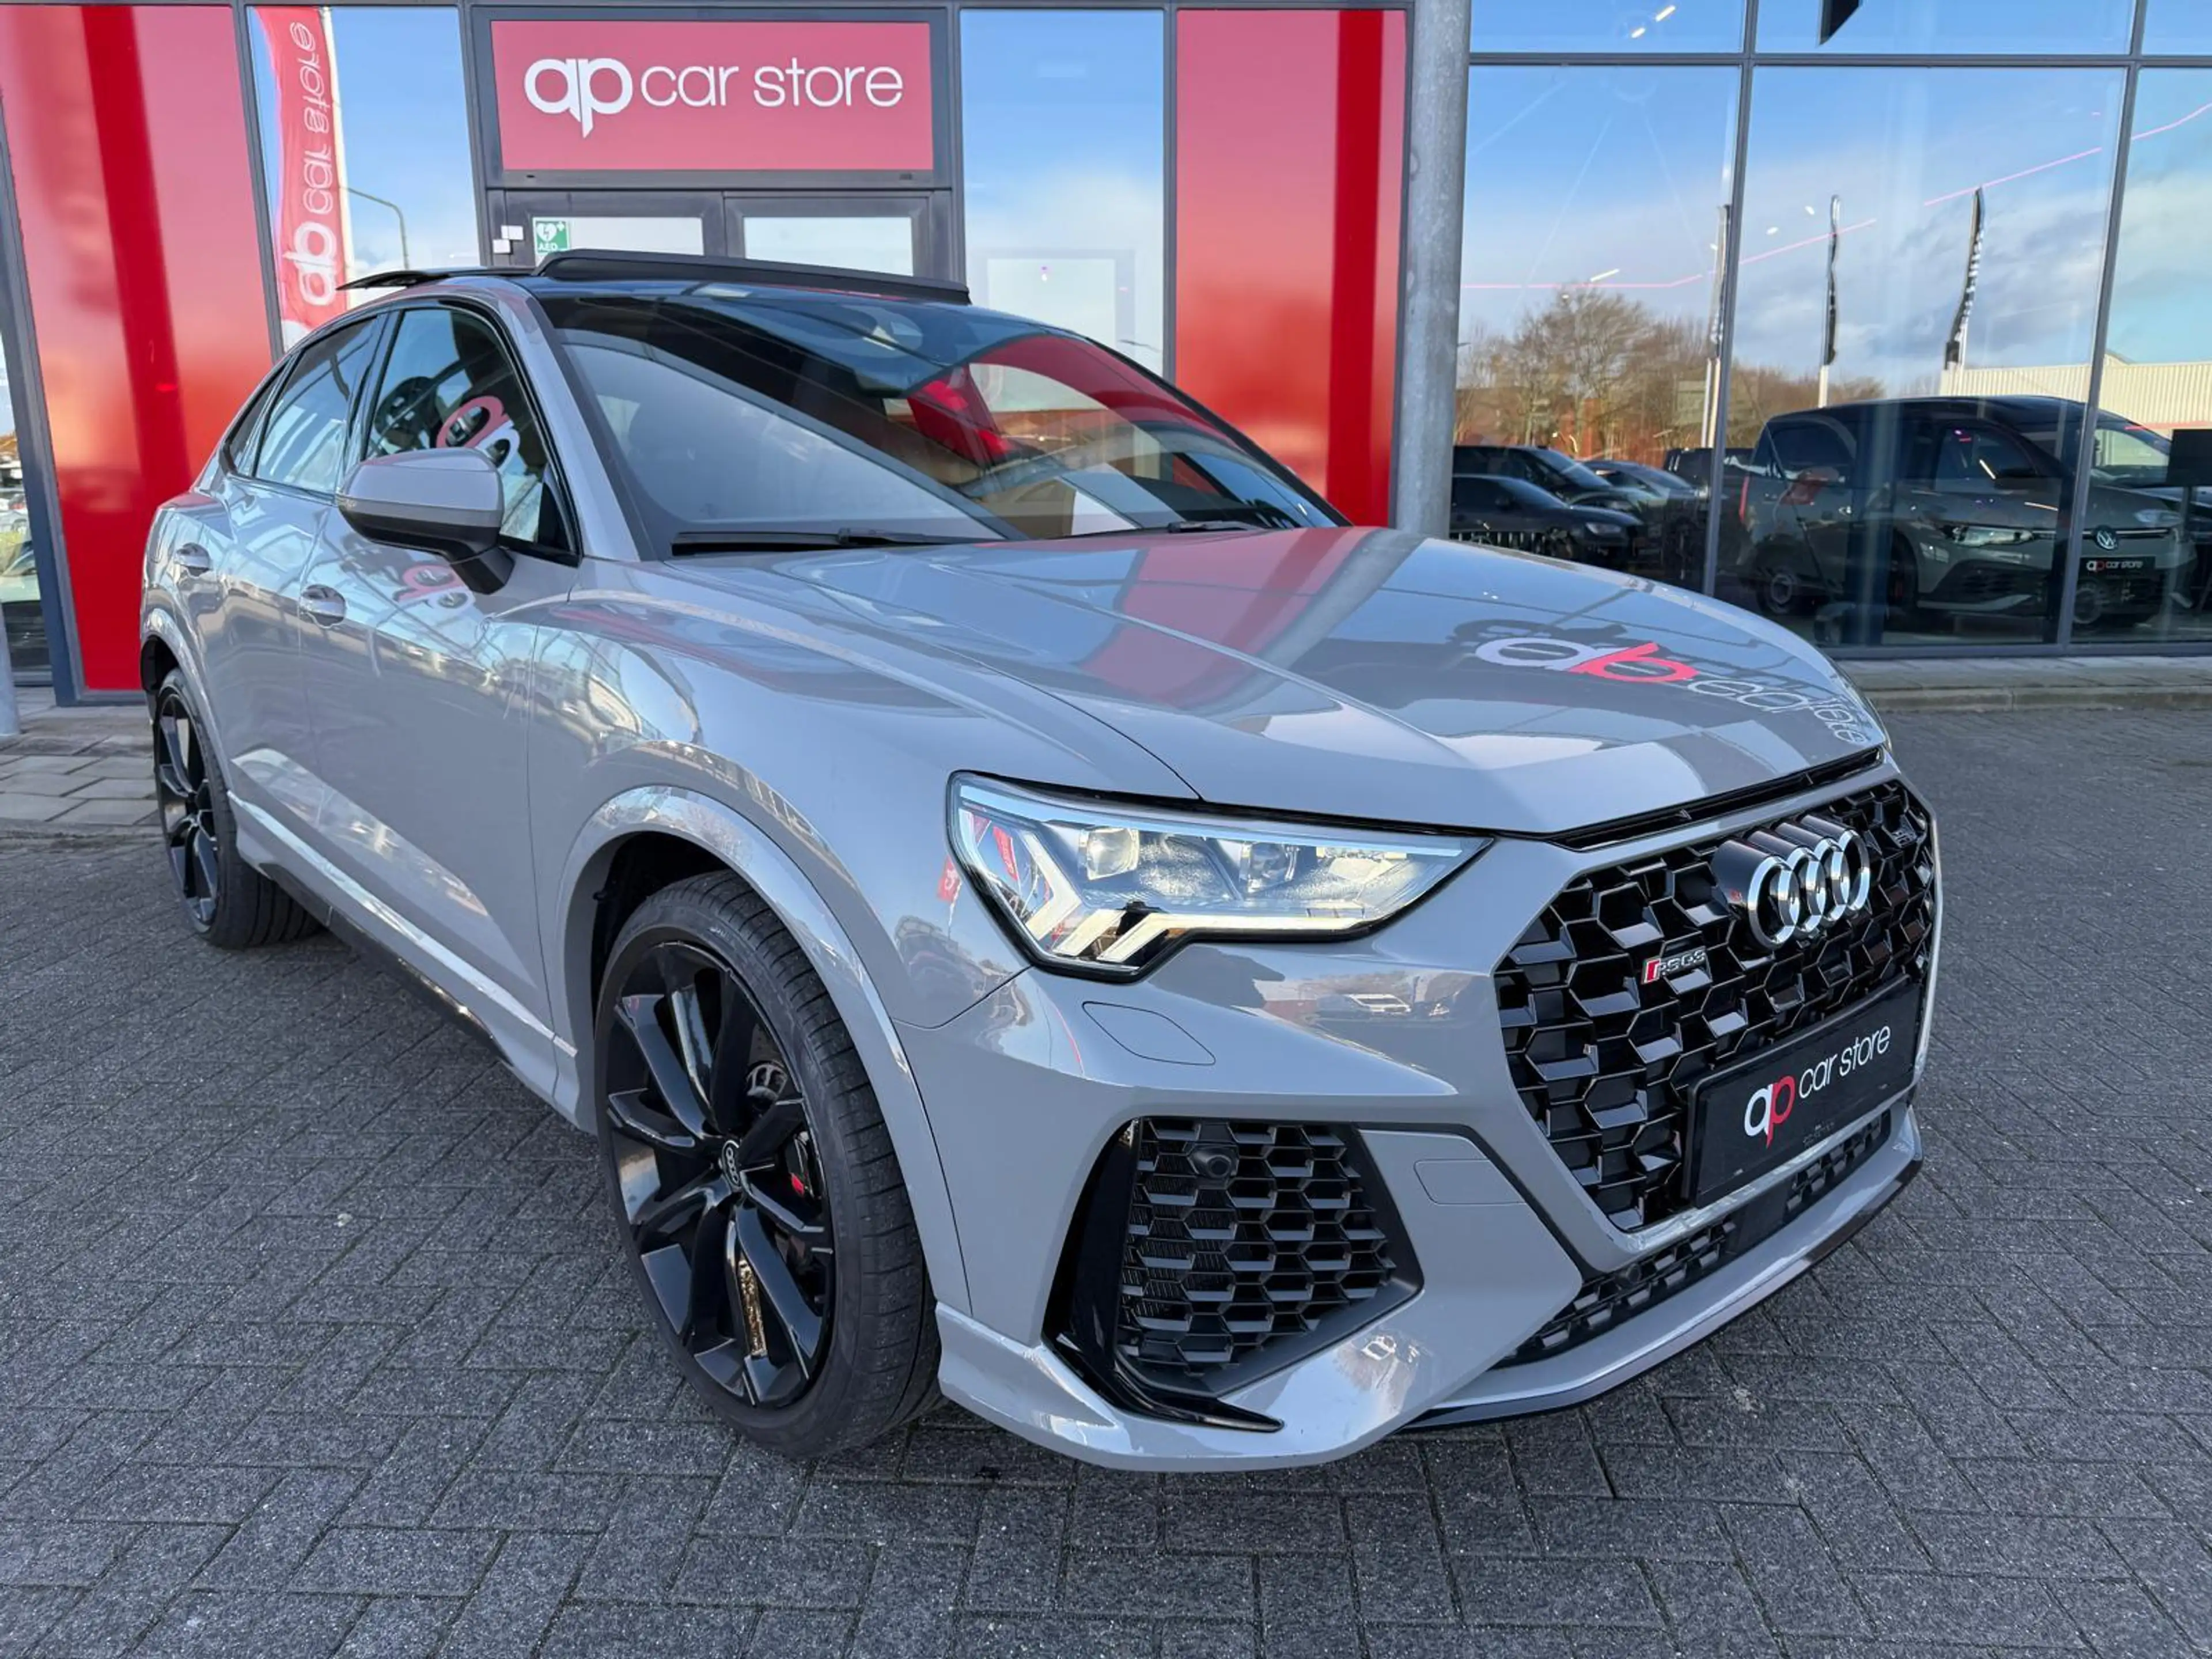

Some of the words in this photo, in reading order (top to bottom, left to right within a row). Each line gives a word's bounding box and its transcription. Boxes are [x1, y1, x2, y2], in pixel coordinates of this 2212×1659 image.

[524, 58, 633, 138] ap
[640, 65, 740, 107] car
[753, 56, 903, 108] store
[538, 242, 558, 251] AED
[1744, 1075, 1796, 1149] ap
[1798, 1054, 1838, 1099] car
[1839, 1025, 1891, 1077] store
